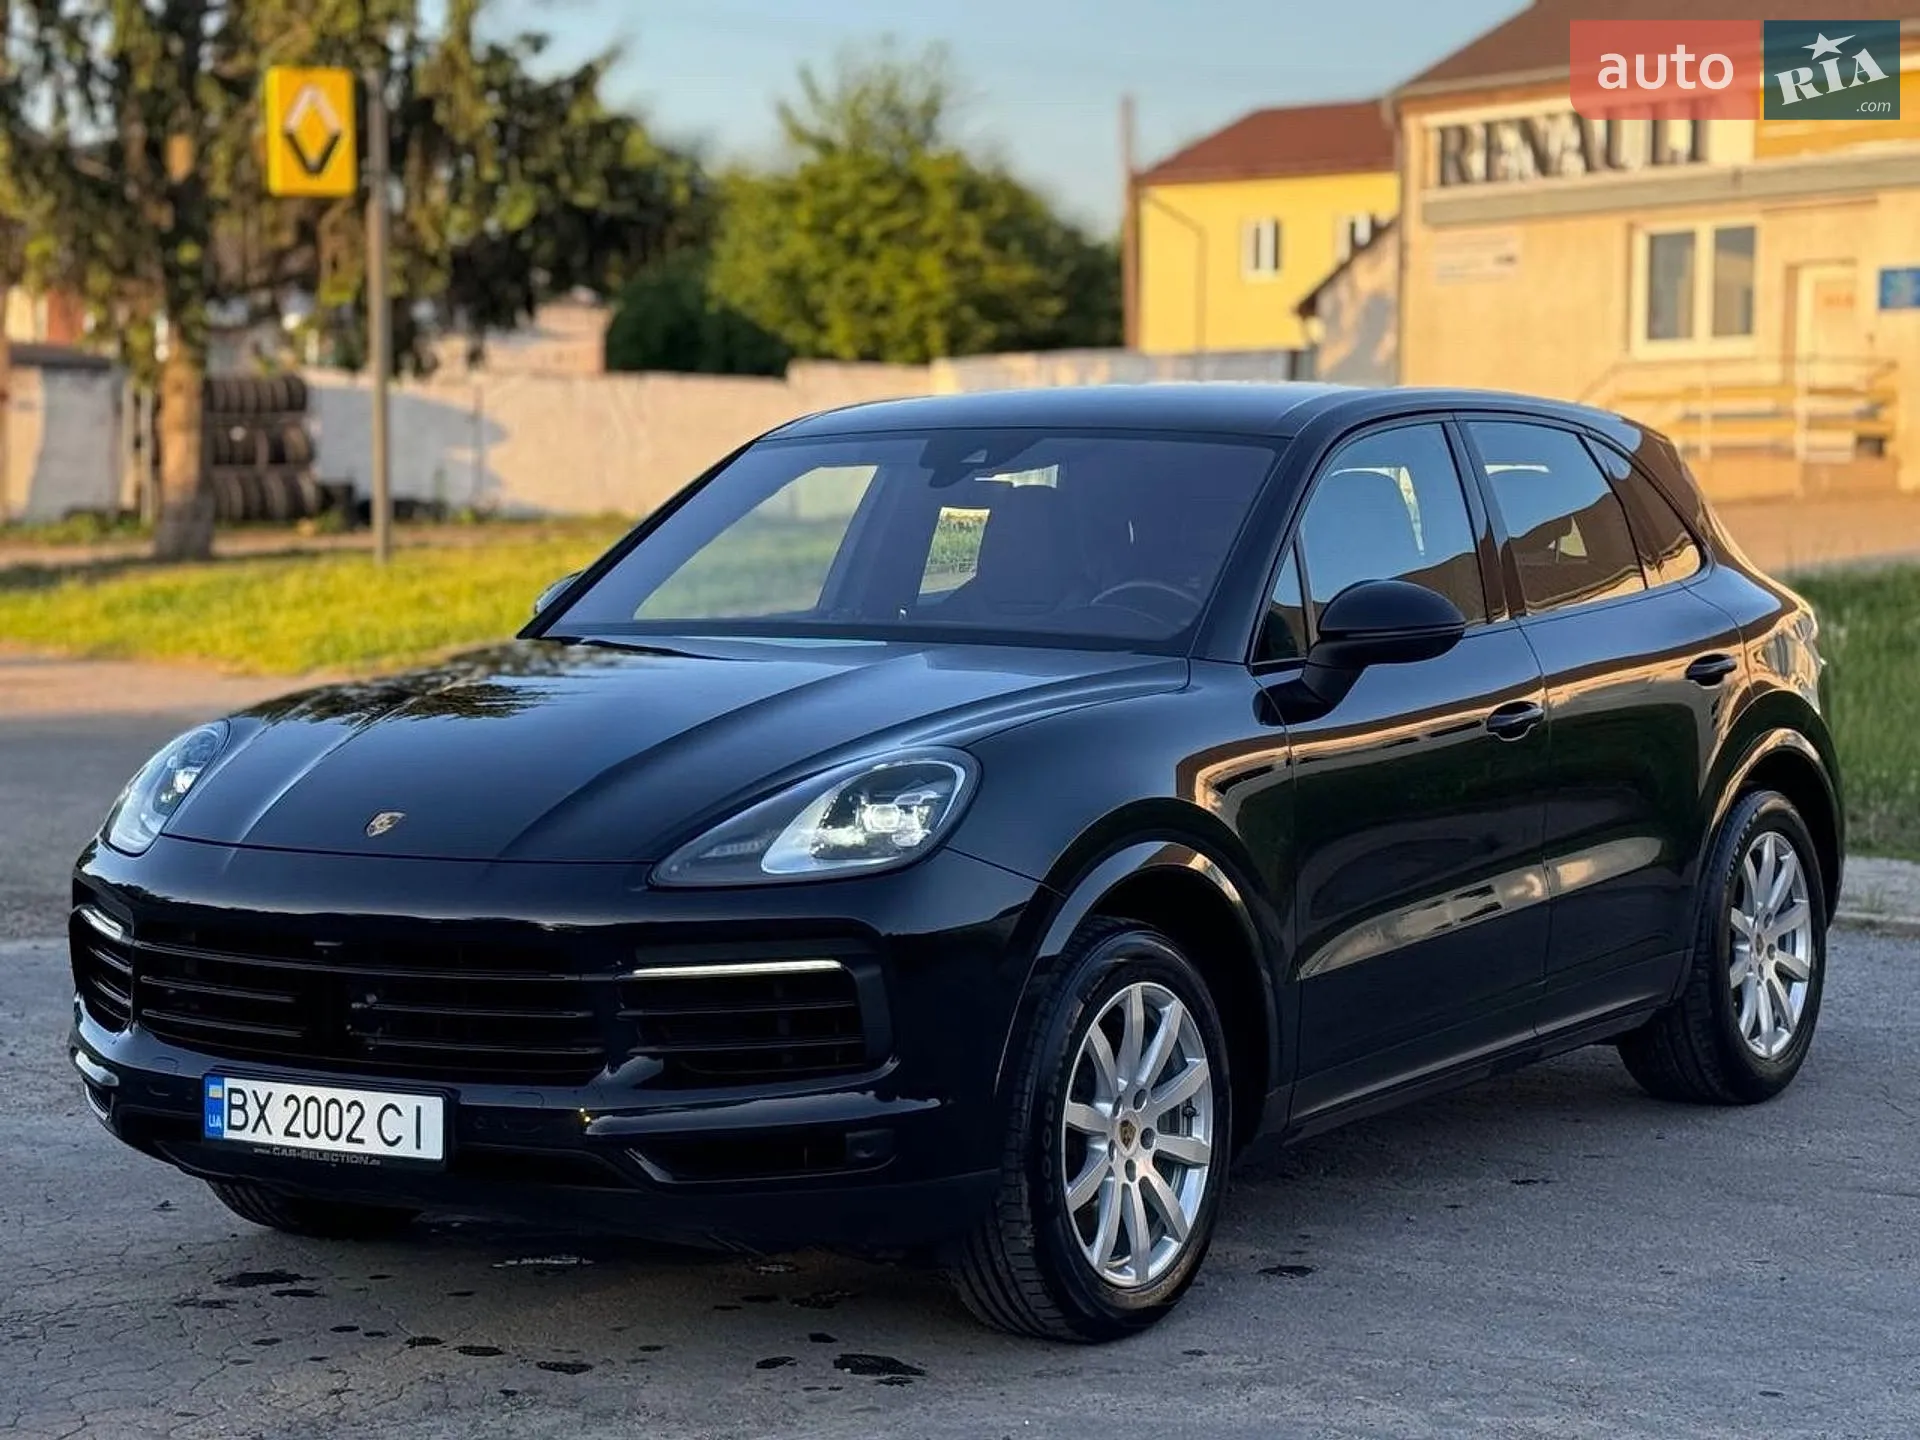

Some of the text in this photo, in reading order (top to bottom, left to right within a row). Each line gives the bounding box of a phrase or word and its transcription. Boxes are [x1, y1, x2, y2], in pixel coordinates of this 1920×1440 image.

[1439, 96, 1718, 187] RENAULT
[208, 1114, 222, 1128] UA
[227, 1087, 422, 1150] BX 2002 CI
